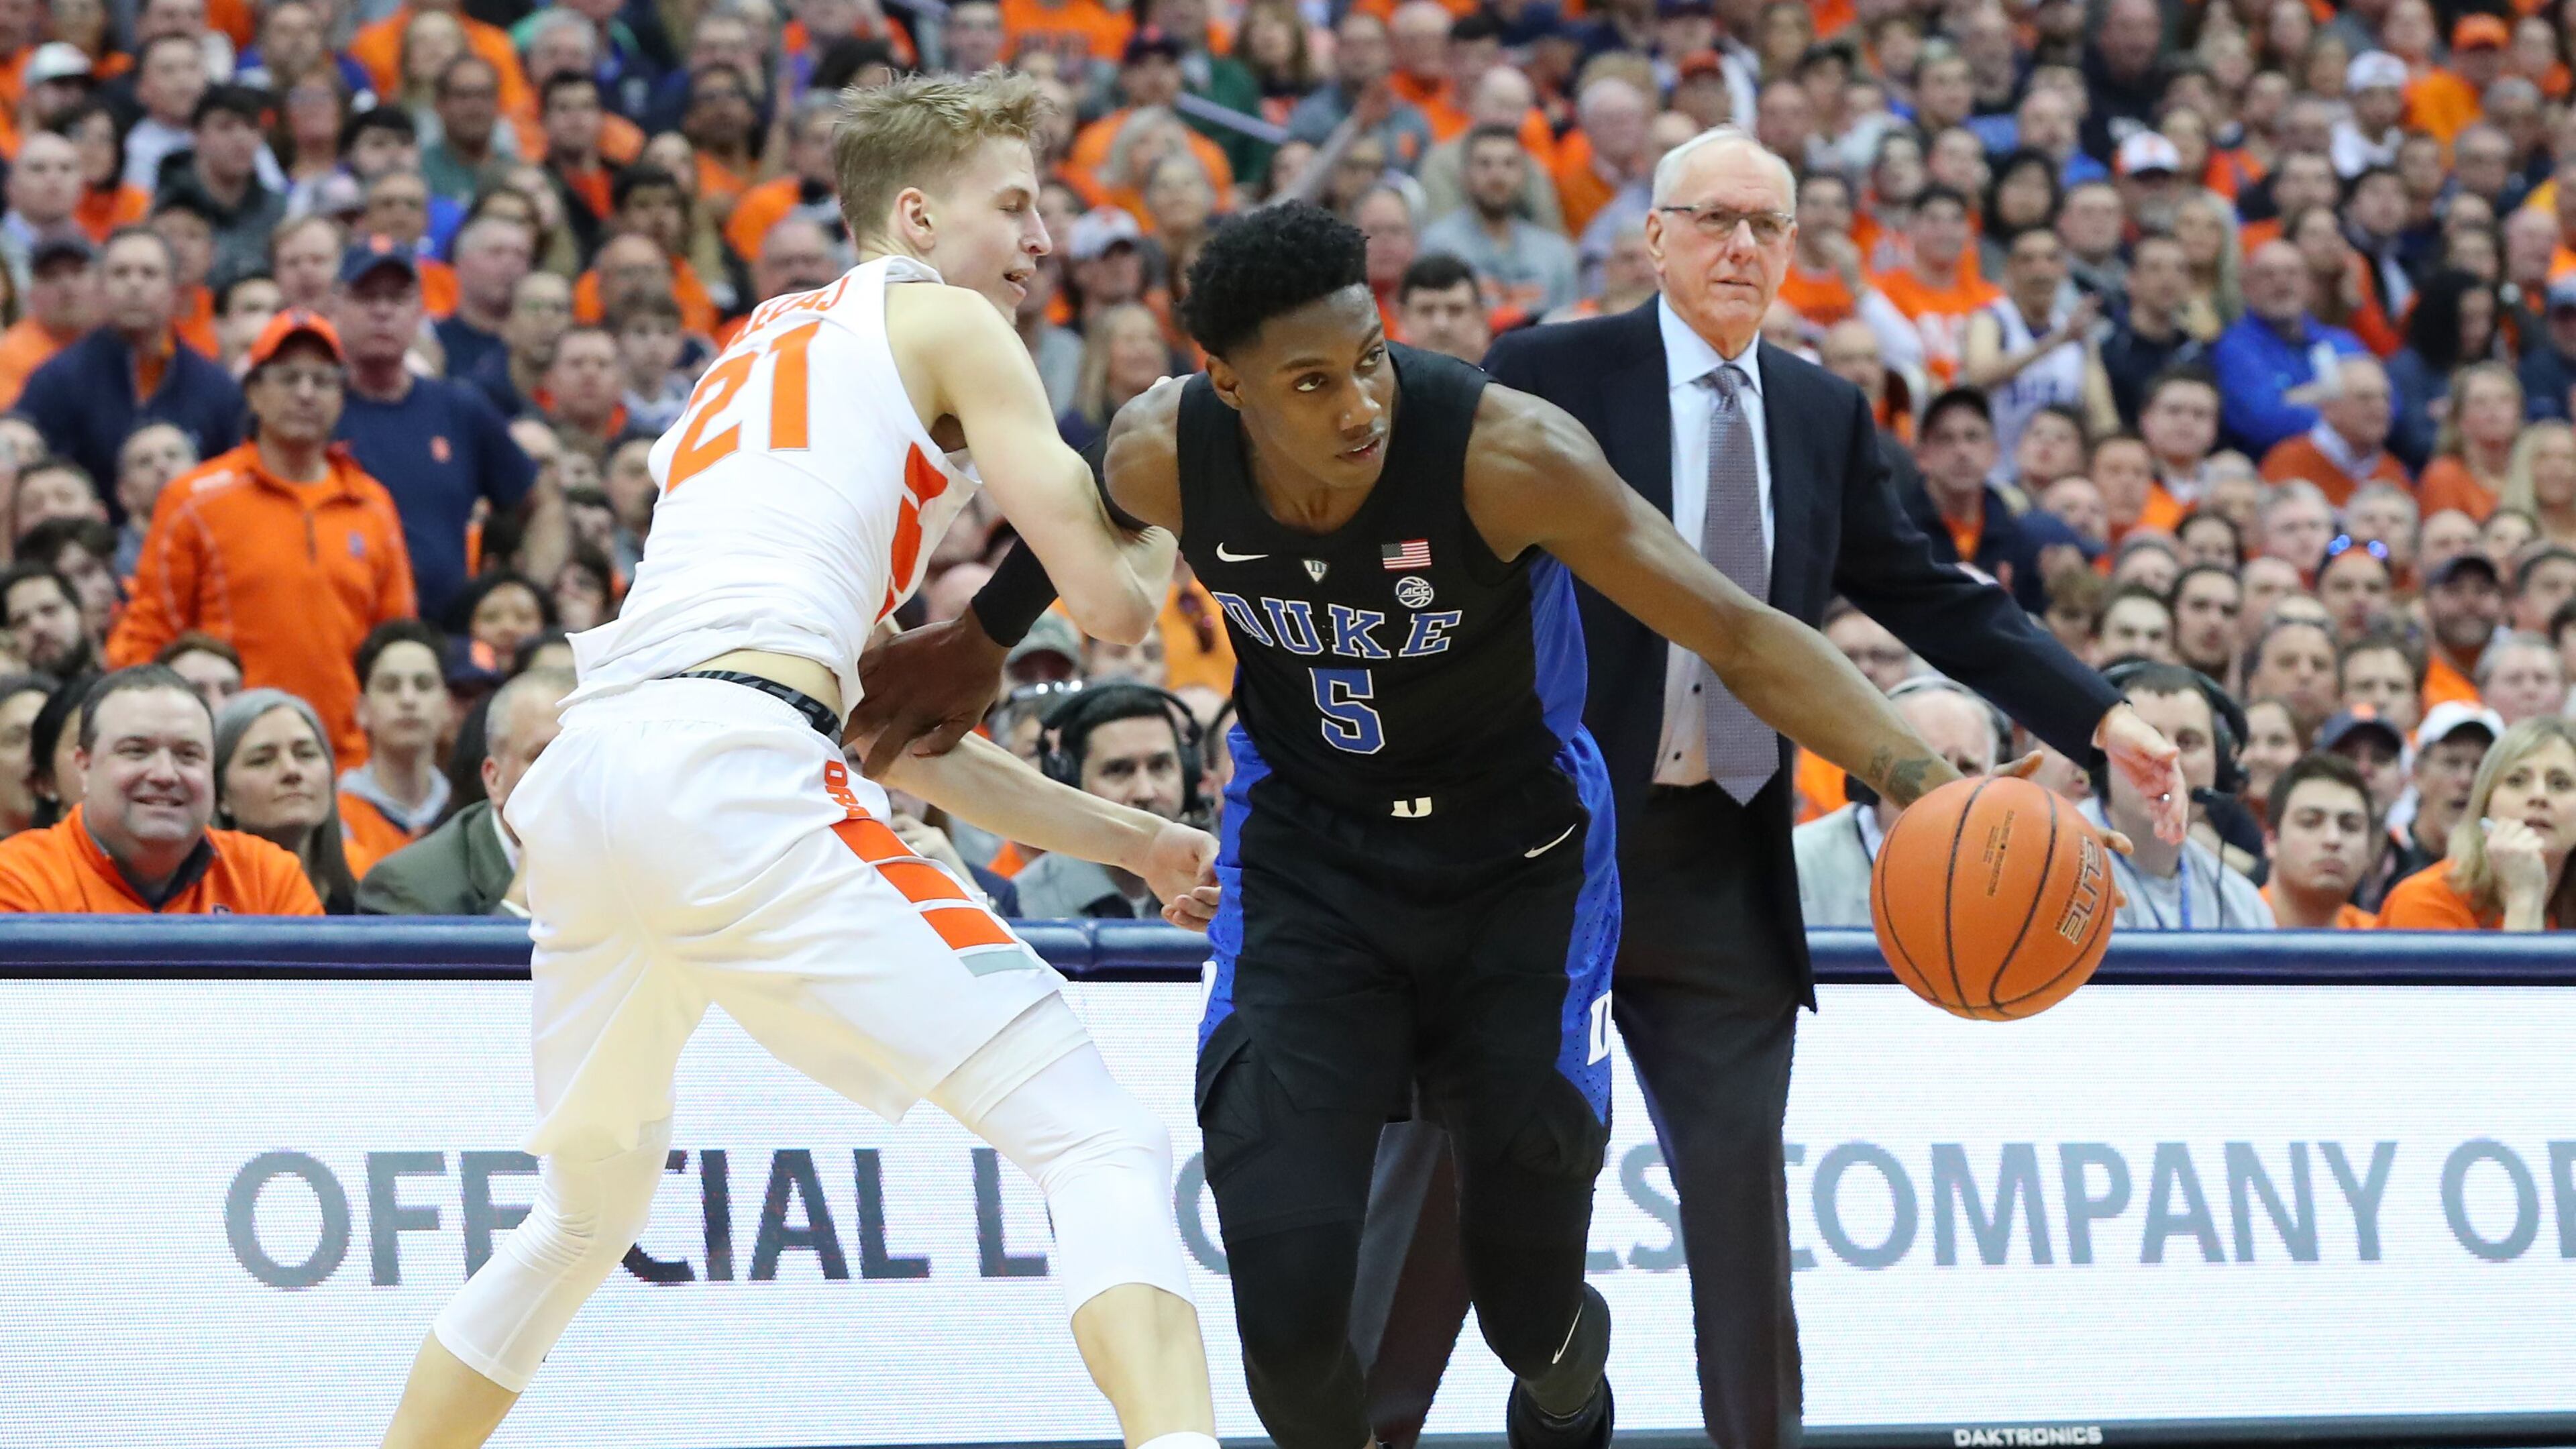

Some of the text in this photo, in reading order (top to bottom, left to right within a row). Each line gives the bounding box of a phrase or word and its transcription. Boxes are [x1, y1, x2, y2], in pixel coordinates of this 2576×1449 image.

[665, 319, 821, 498] 21
[1212, 592, 1462, 659] DUKE
[1400, 586, 1430, 597] ACC
[1307, 667, 1385, 755] 5
[2059, 836, 2102, 945] ELITE
[224, 1148, 930, 1291] OFFIAL
[1786, 1139, 2399, 1269] OMPANY
[1953, 1426, 2103, 1447] DAKTRONICS
